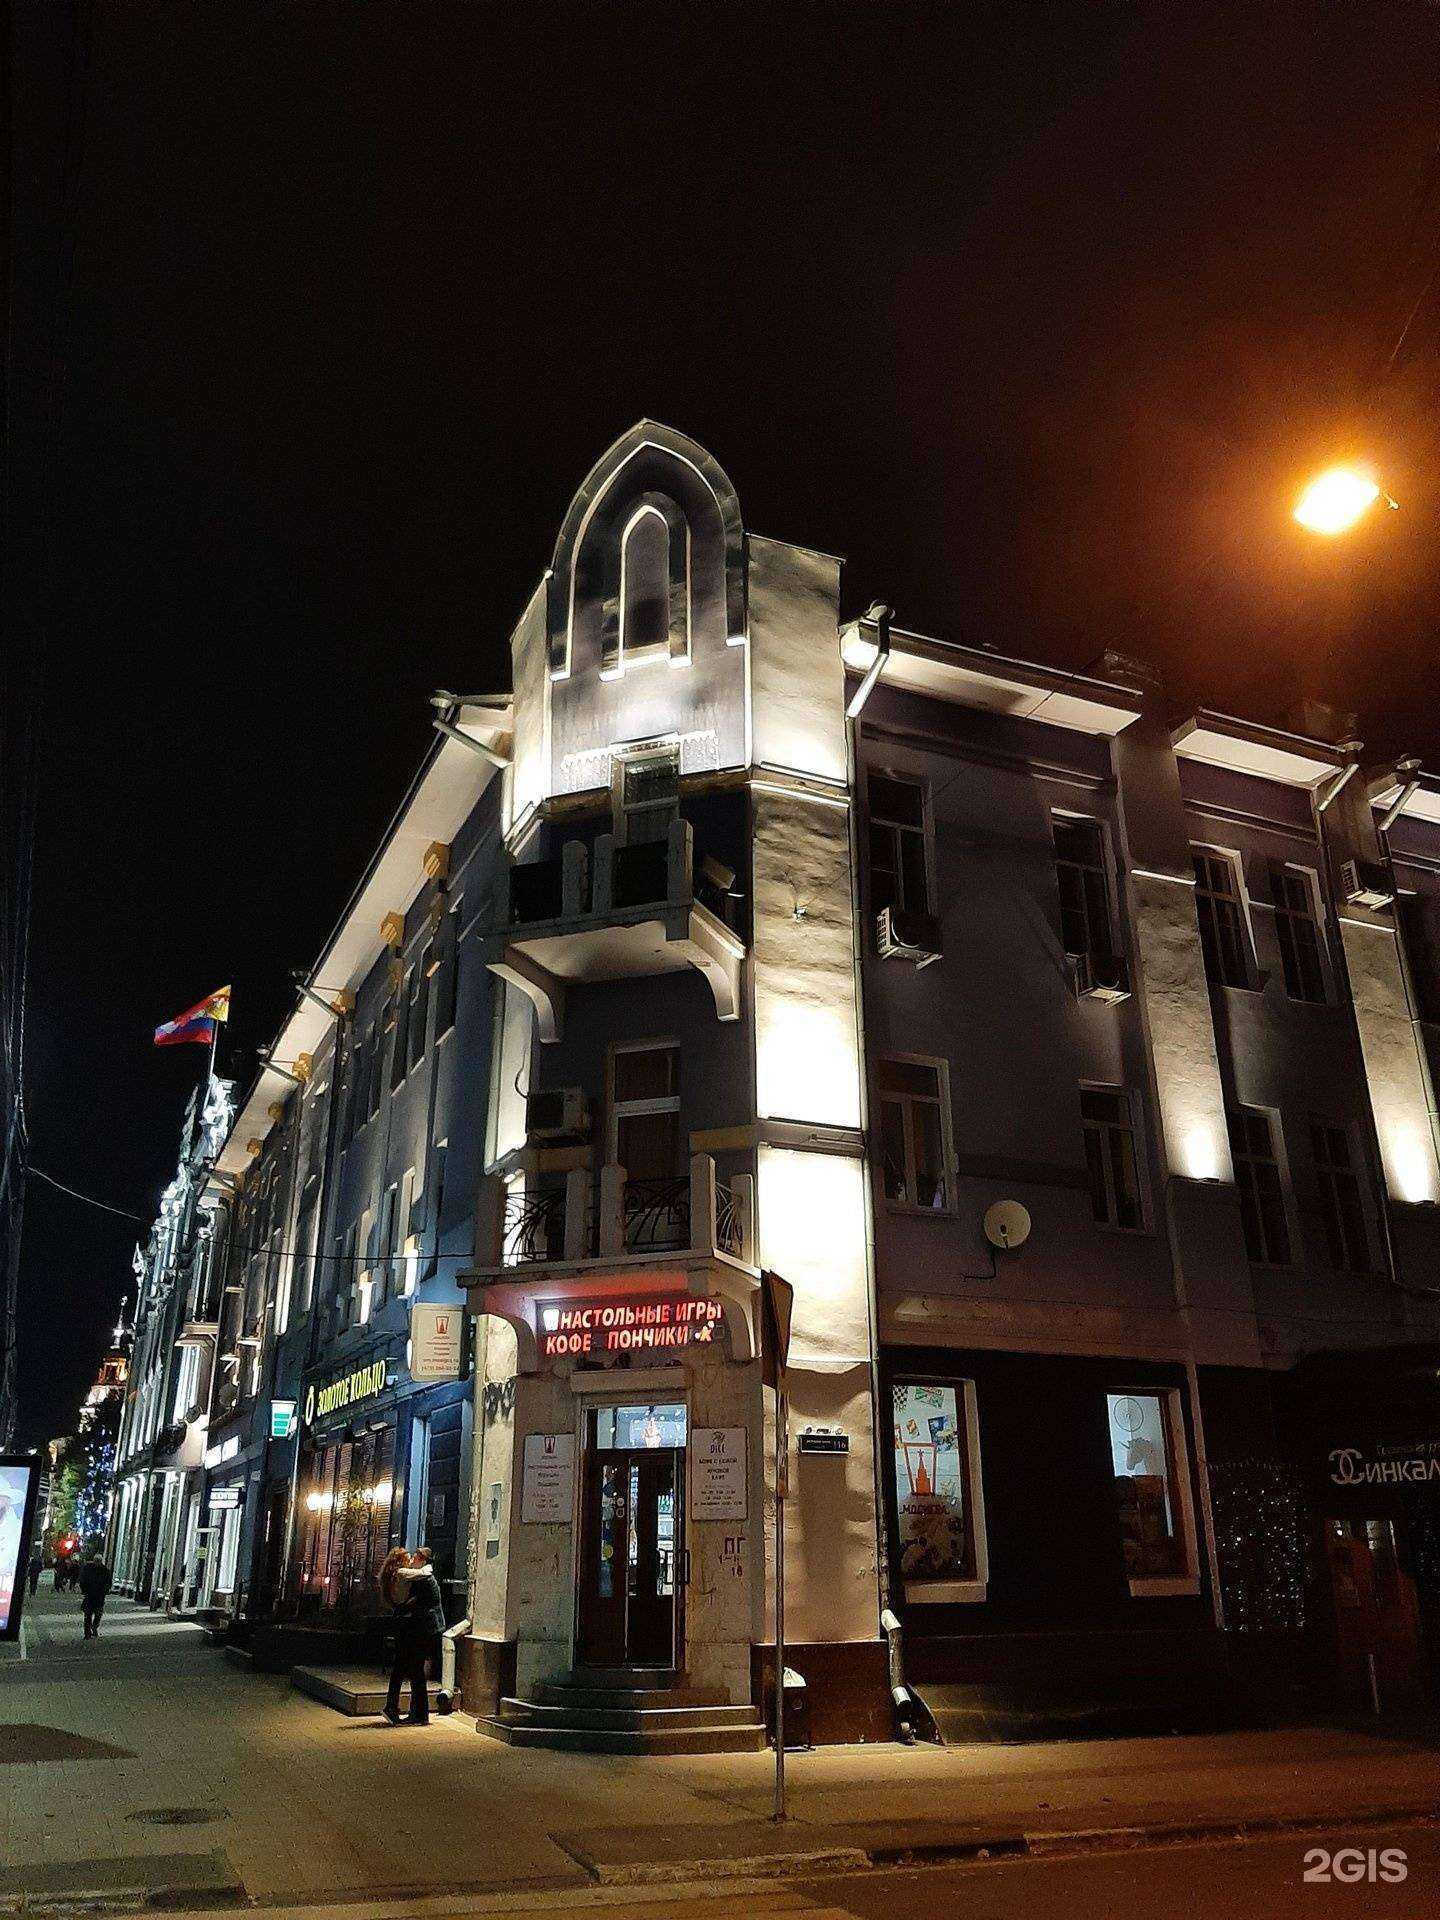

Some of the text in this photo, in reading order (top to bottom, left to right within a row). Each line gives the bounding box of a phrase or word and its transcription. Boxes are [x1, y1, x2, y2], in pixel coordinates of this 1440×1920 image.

[560, 1301, 723, 1330] НАСТОЛЬНЫЕ ИГРЫ
[546, 1325, 689, 1355] КОФЕ ПОНЧИКИ
[349, 1360, 386, 1403] КОЛЬЦО
